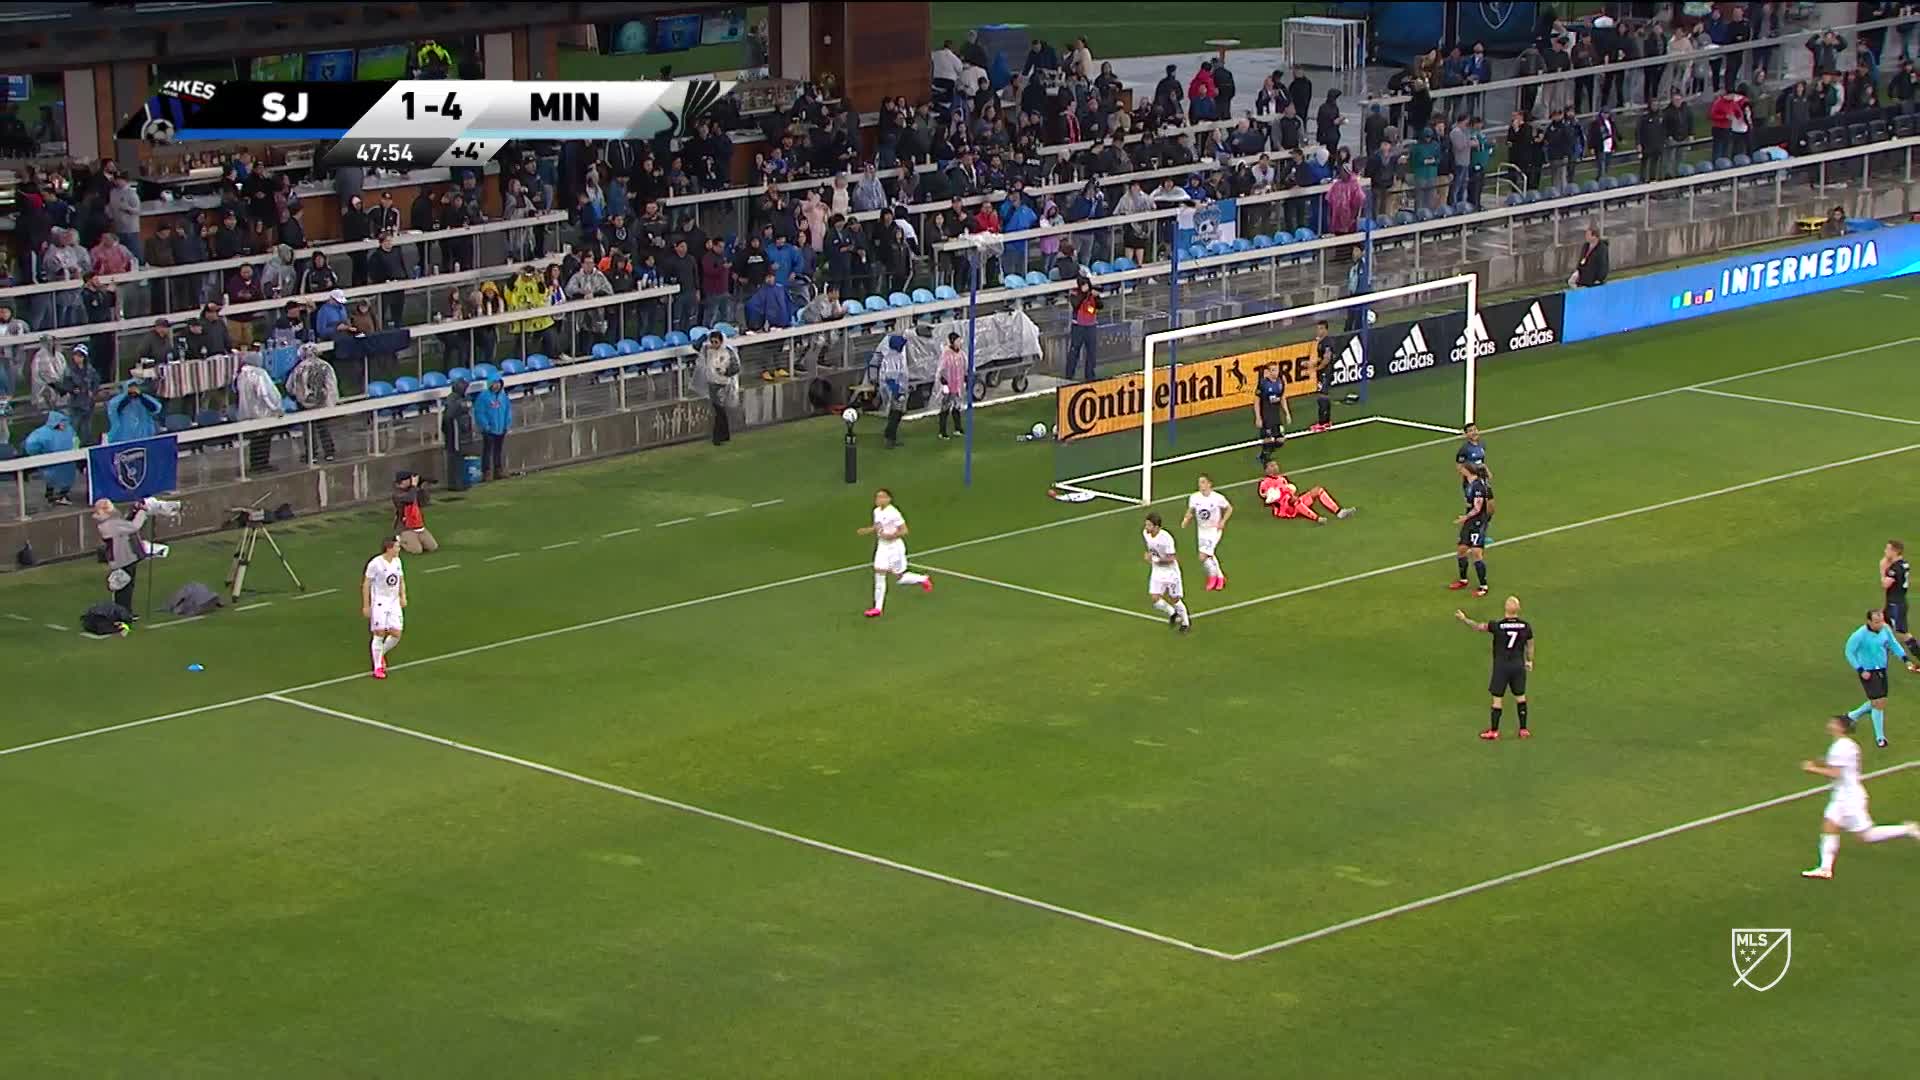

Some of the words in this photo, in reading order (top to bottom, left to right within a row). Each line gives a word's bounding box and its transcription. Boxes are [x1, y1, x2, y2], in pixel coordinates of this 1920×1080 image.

[1721, 240, 1879, 297] INTERMEDIA
[1450, 339, 1496, 362] addas
[1509, 328, 1554, 351] adidas
[1253, 355, 1310, 388] TRE
[1388, 352, 1434, 374] adidas
[1506, 631, 1518, 649] 7
